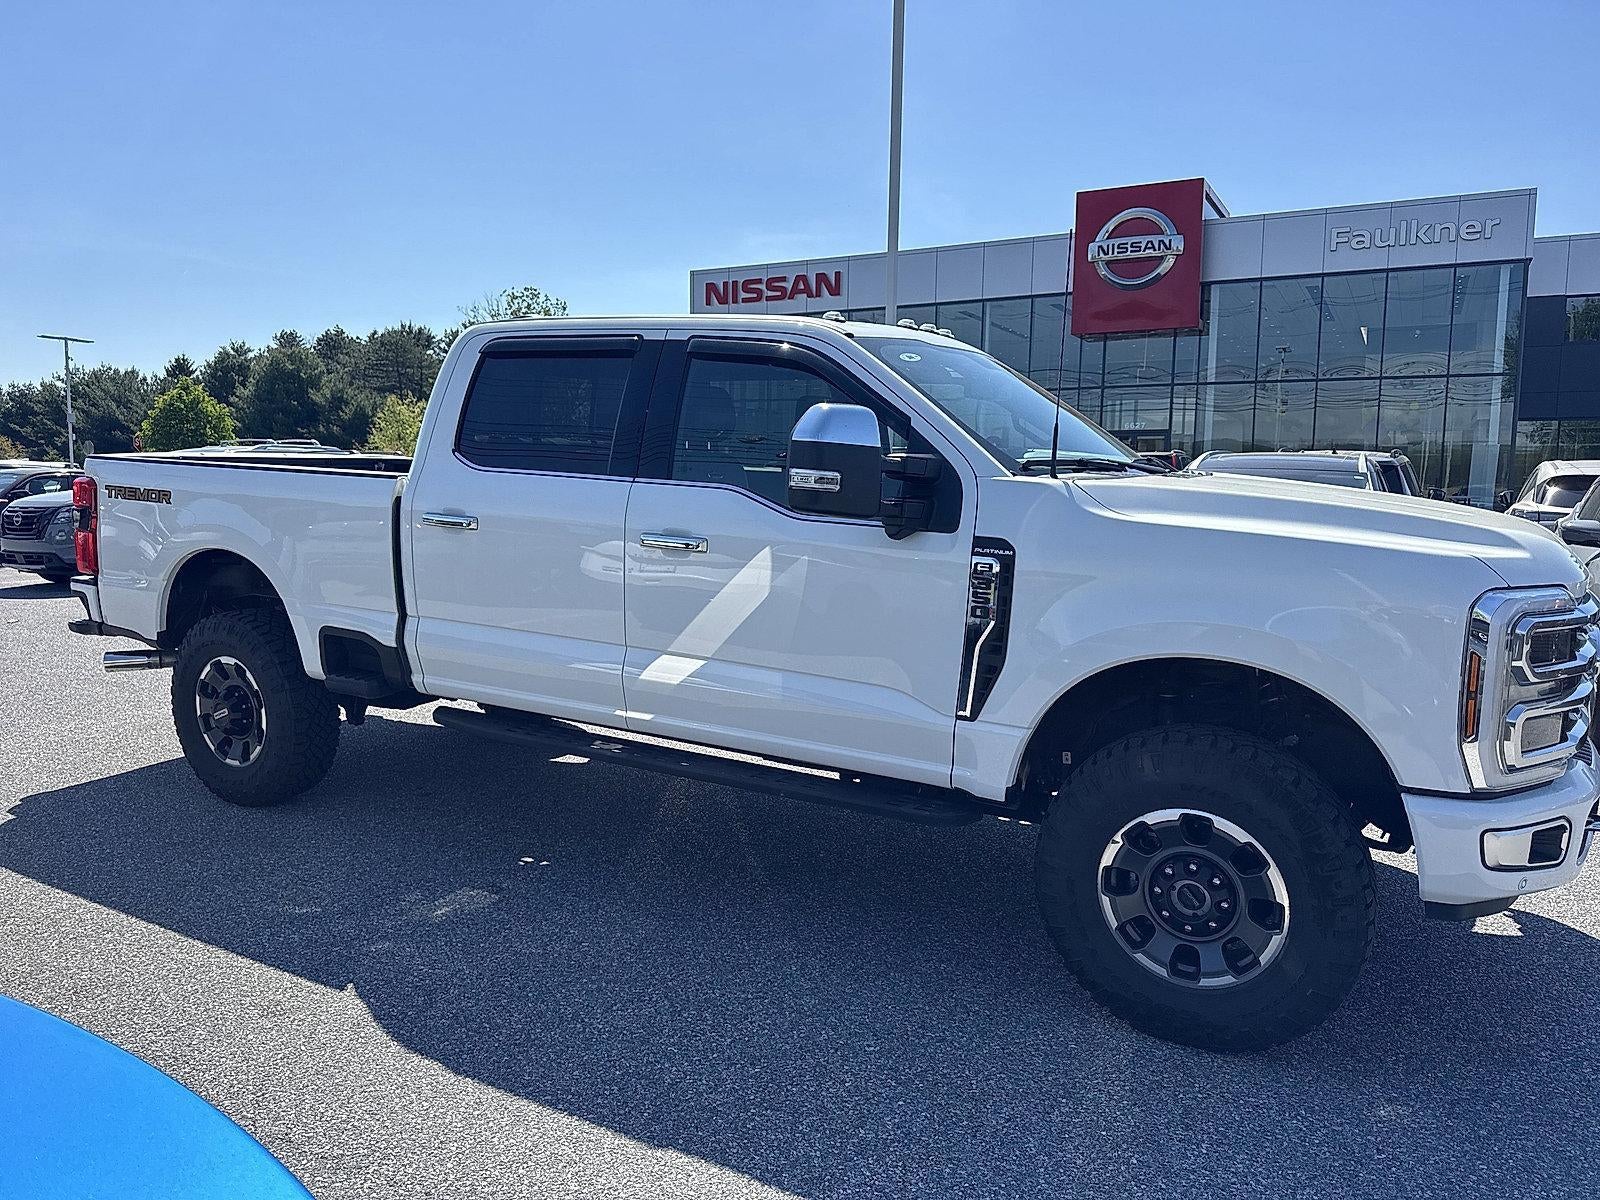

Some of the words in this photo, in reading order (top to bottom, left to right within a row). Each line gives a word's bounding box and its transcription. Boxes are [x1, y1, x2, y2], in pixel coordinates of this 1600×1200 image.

[1330, 217, 1500, 251] Faulkner
[1097, 238, 1173, 257] NISSAN
[705, 270, 842, 306] NISSAN
[1124, 422, 1146, 430] 6627
[105, 484, 172, 505] TREMOR
[974, 547, 1013, 555] PLATINUM
